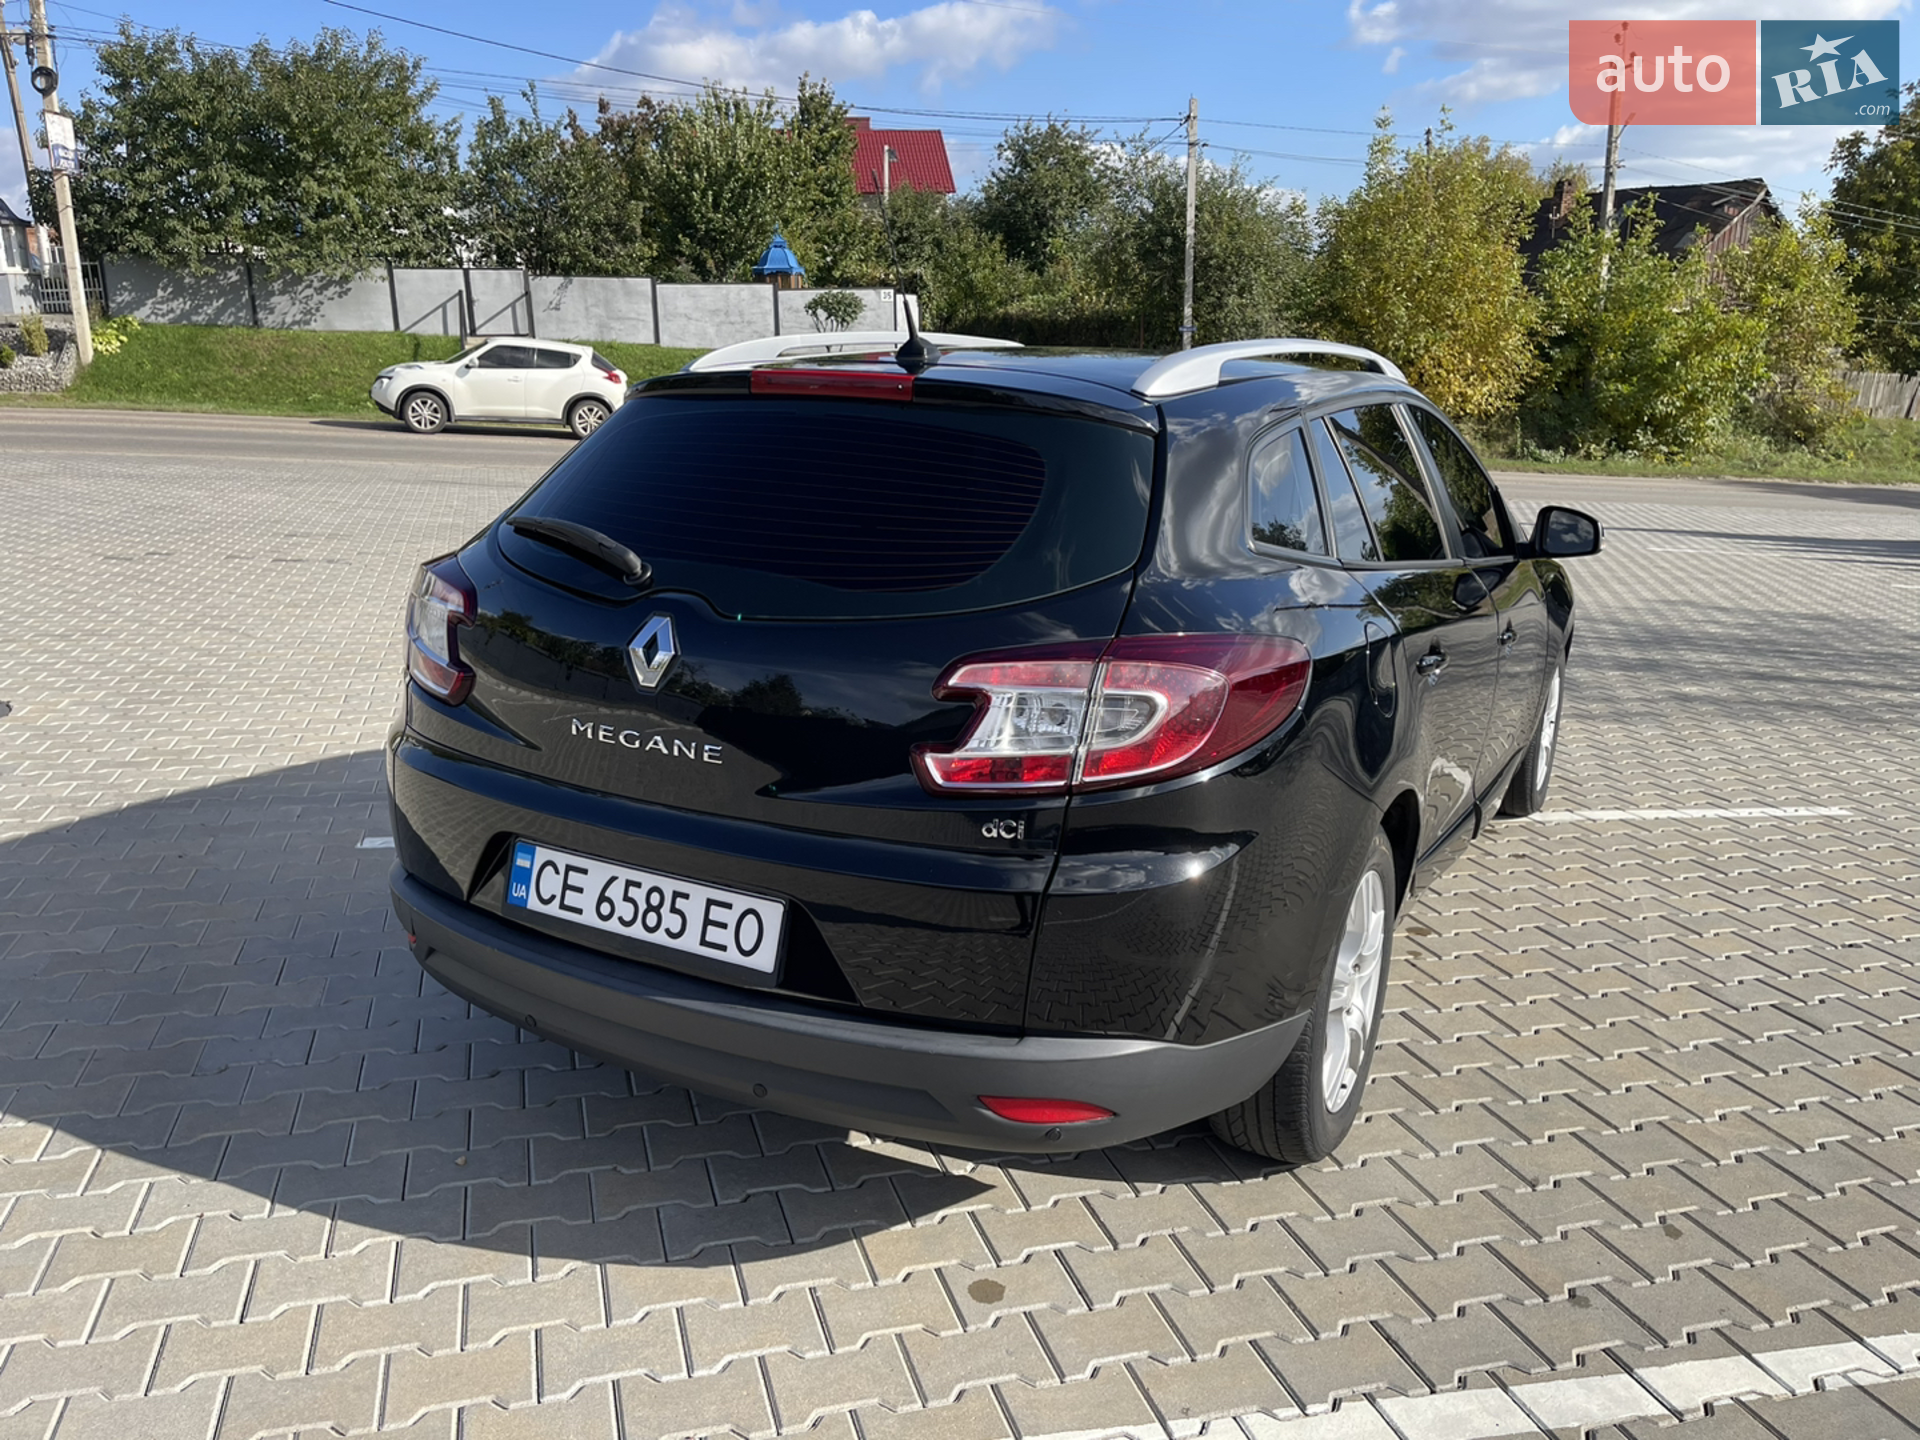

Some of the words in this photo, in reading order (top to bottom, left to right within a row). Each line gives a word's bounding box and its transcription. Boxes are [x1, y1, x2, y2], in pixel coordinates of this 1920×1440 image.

[571, 718, 723, 764] MEGANE
[981, 818, 1025, 840] dCi
[511, 882, 527, 900] UA
[535, 859, 589, 915] CE
[595, 875, 690, 940] 6585
[699, 897, 764, 957] EO
